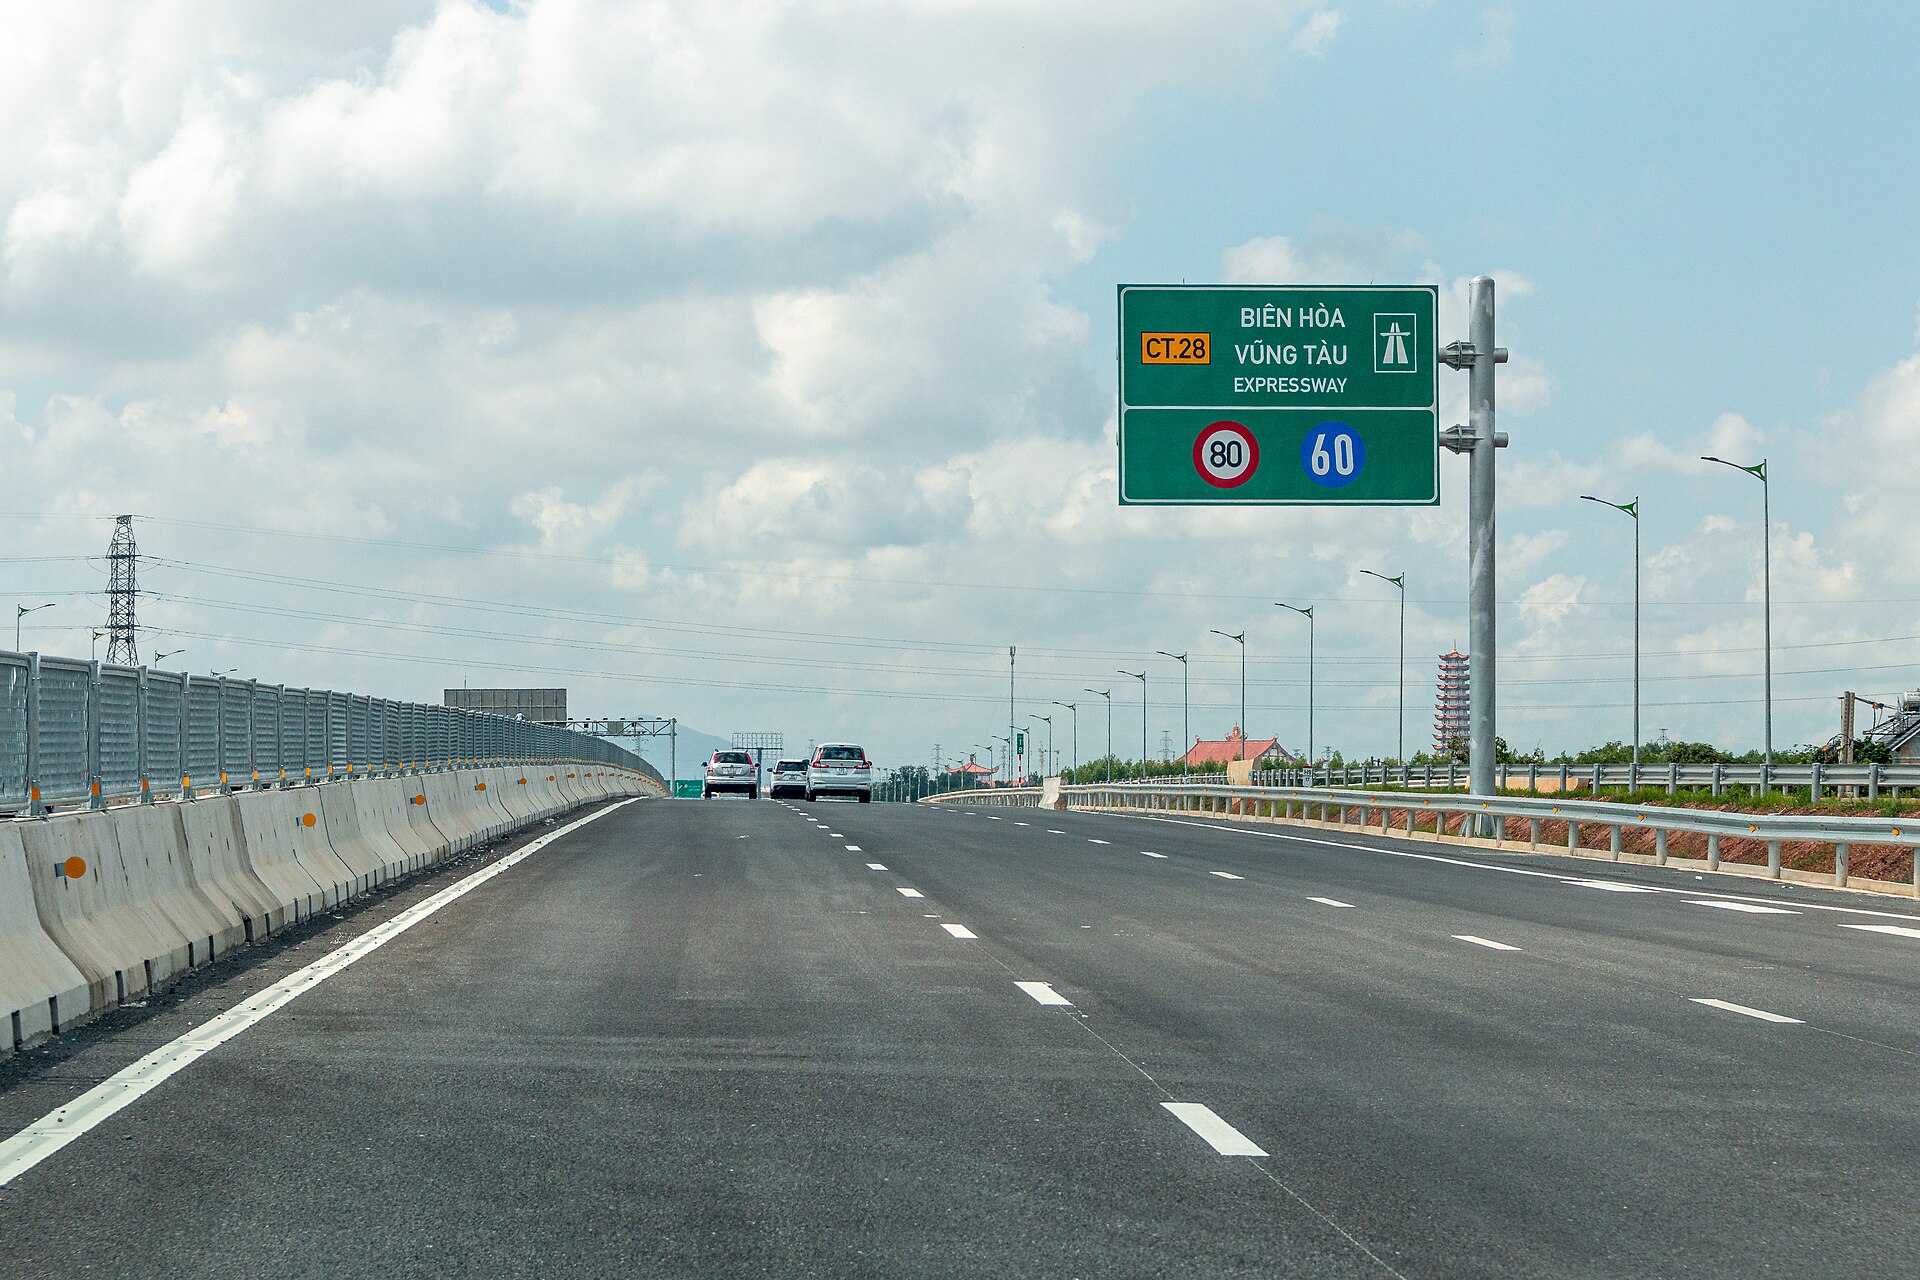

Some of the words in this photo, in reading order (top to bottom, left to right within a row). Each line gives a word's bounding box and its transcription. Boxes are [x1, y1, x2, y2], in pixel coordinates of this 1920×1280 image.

[1240, 303, 1292, 328] BIÊN
[1299, 303, 1346, 328] HÒA
[1145, 337, 1207, 360] CT.28
[1234, 340, 1297, 365] VŨNG
[1303, 340, 1348, 365] TÀU
[1234, 377, 1347, 393] EXPRESSWAY
[1209, 440, 1243, 468] 80
[1311, 433, 1354, 476] 60
